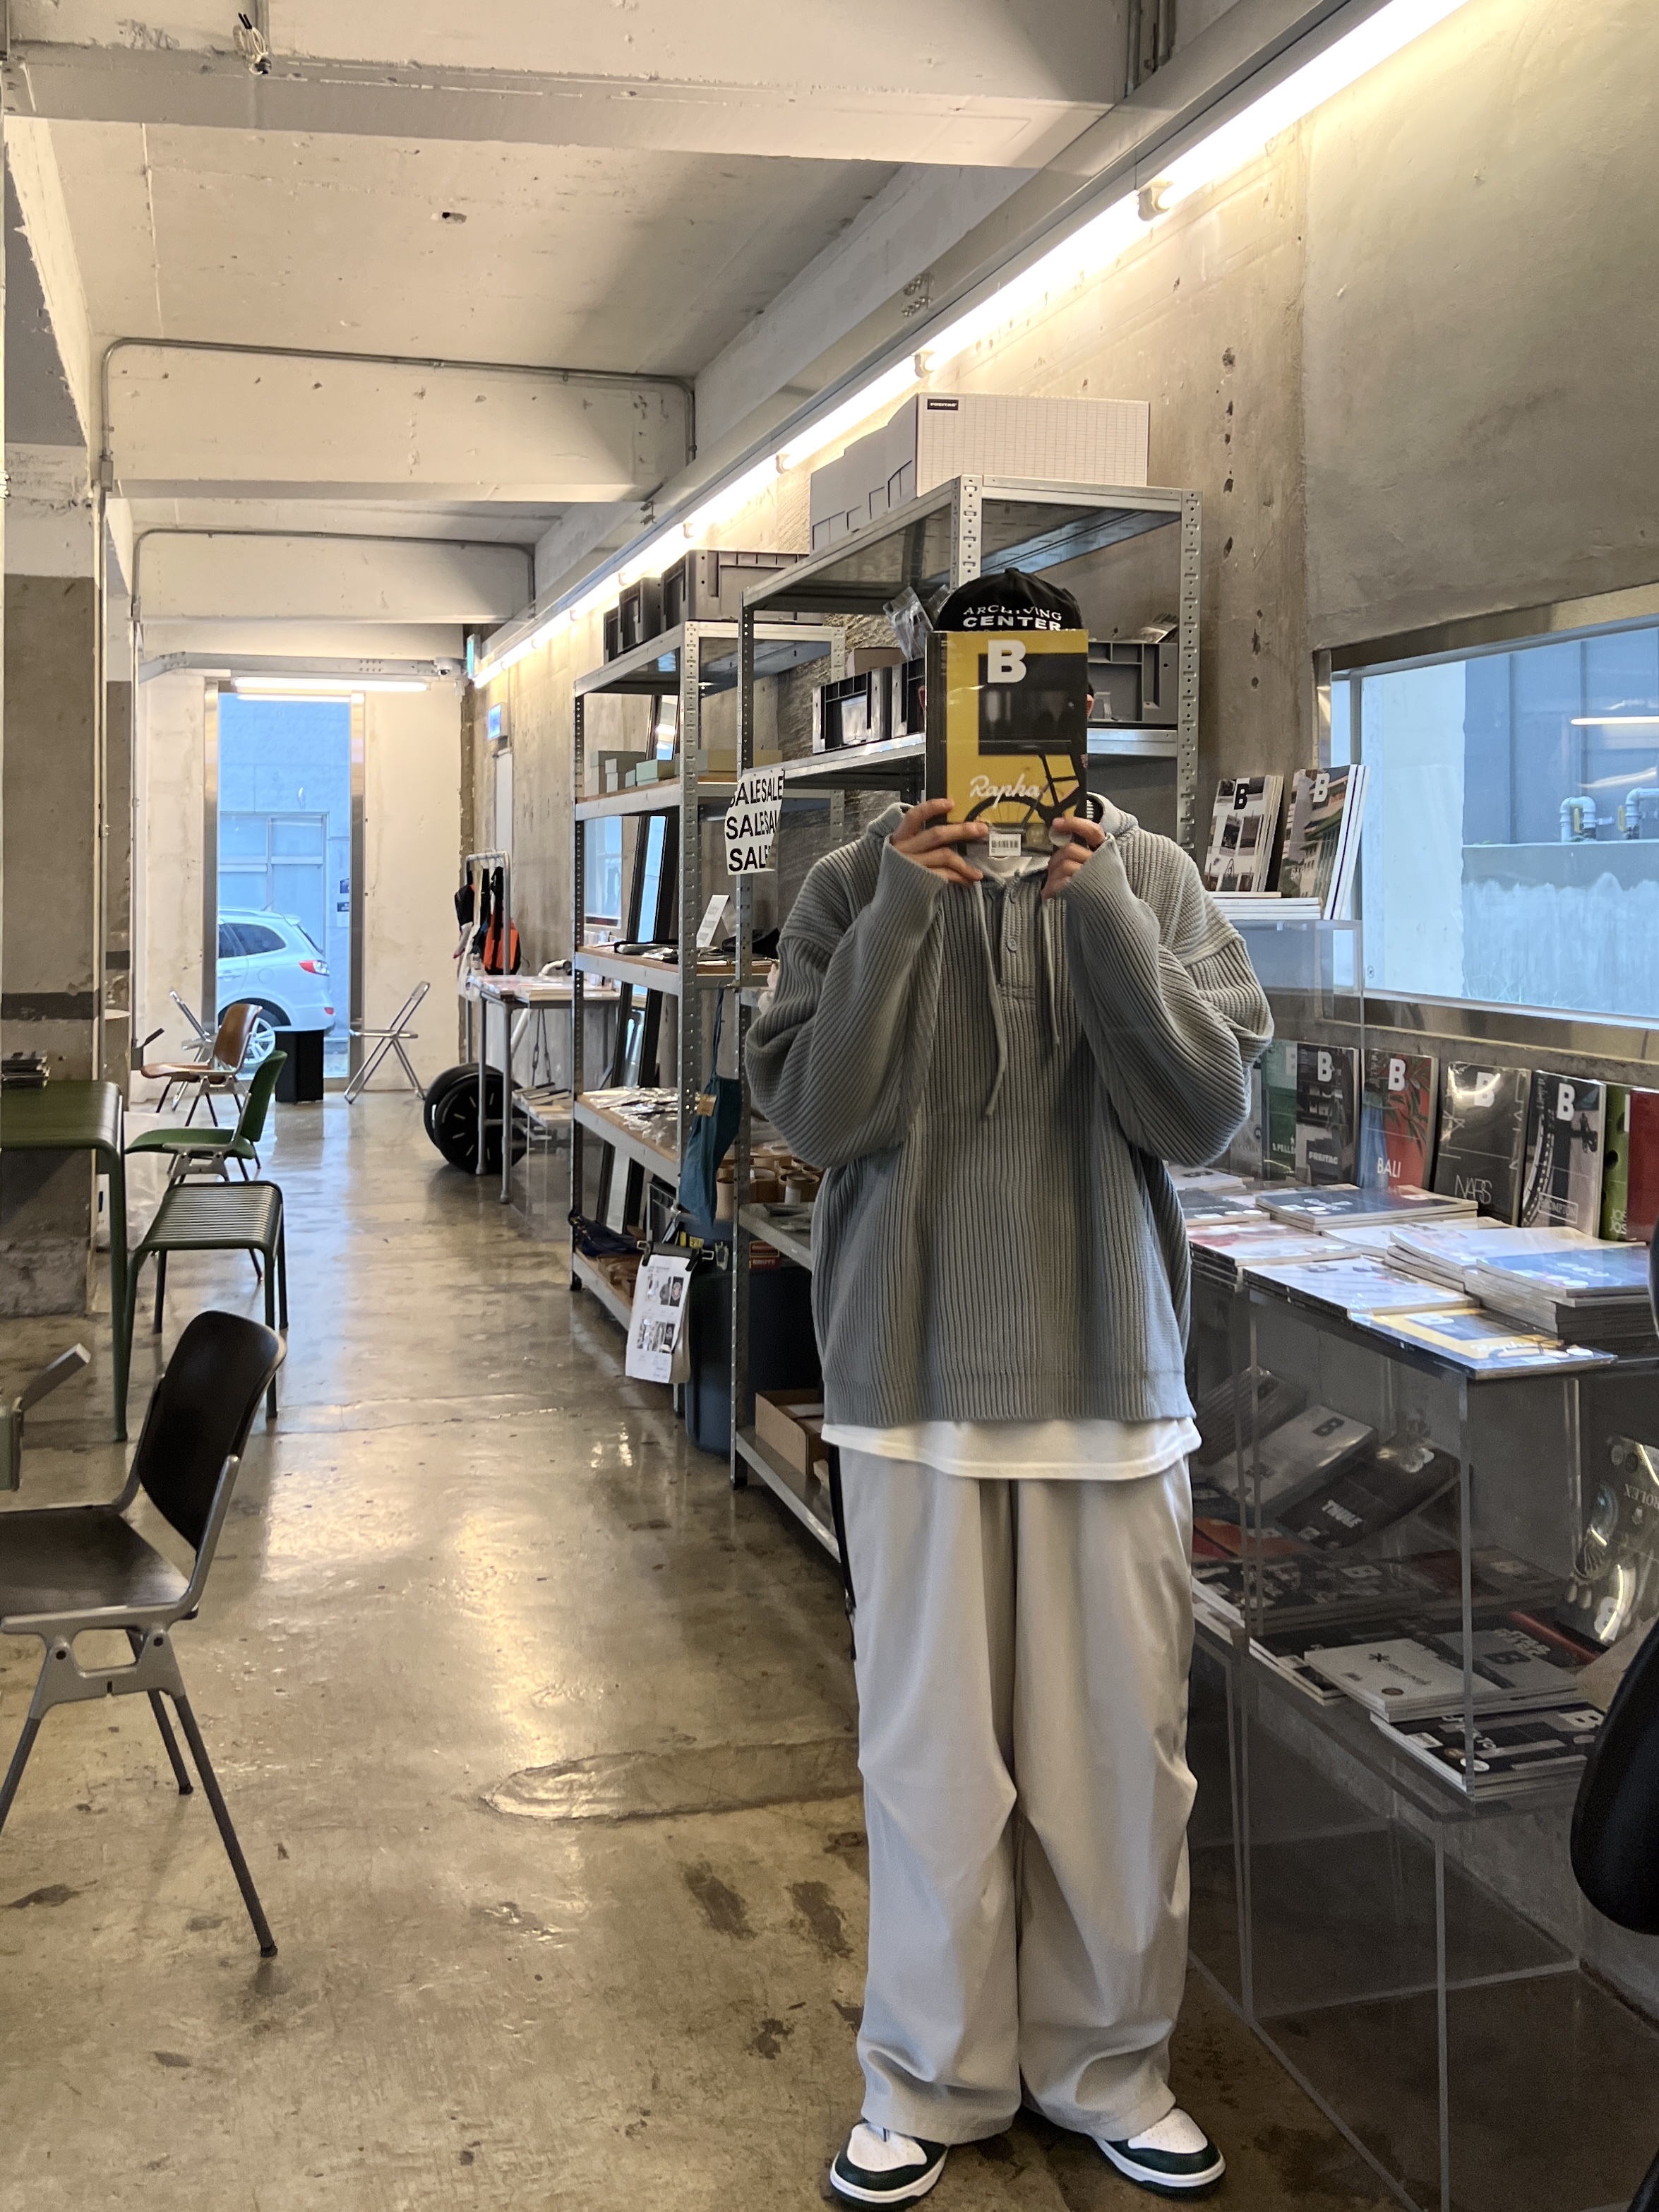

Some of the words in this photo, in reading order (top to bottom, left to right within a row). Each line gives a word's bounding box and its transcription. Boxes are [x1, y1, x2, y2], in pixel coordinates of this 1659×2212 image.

[963, 616, 1061, 631] CENTER
[988, 640, 1026, 683] B
[970, 774, 1043, 808] Rapha
[1234, 783, 1250, 811] B
[1313, 773, 1331, 803] B
[1318, 1051, 1333, 1082] B
[1389, 1058, 1406, 1091] B
[1474, 1072, 1495, 1108] B
[1557, 1083, 1575, 1121] B
[1309, 1151, 1338, 1165] FREITAG
[1377, 1157, 1401, 1178] BALI
[1455, 1175, 1492, 1204] NARS
[1312, 1417, 1345, 1437] B
[1483, 1650, 1531, 1665] B
[1558, 1709, 1605, 1729] B
